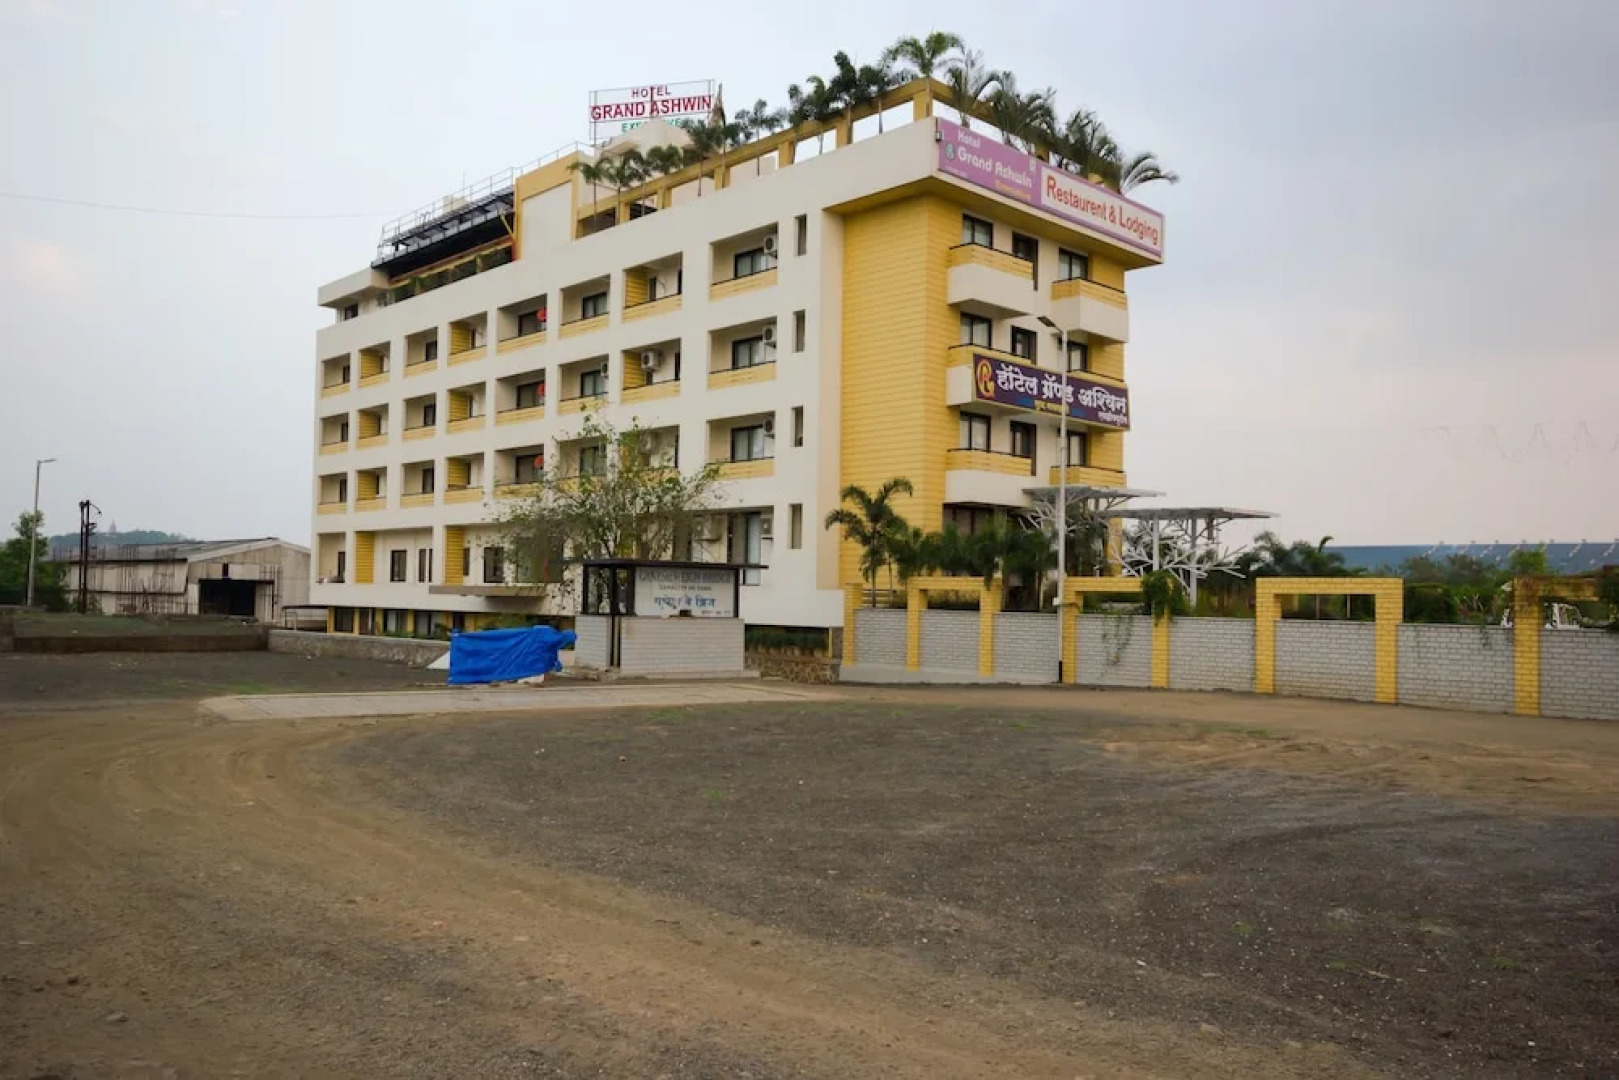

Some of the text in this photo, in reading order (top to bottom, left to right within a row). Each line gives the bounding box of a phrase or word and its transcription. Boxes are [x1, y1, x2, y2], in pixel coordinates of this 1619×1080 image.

[590, 95, 713, 121] GRAND ASHWIN
[631, 85, 672, 98] HOTEL
[958, 146, 993, 172] Grand
[995, 161, 1032, 189] Ashwin
[1046, 174, 1107, 221] Restaurent
[1108, 204, 1116, 225] &
[1119, 205, 1159, 246] Lodging
[995, 363, 1038, 396] हॉटेल
